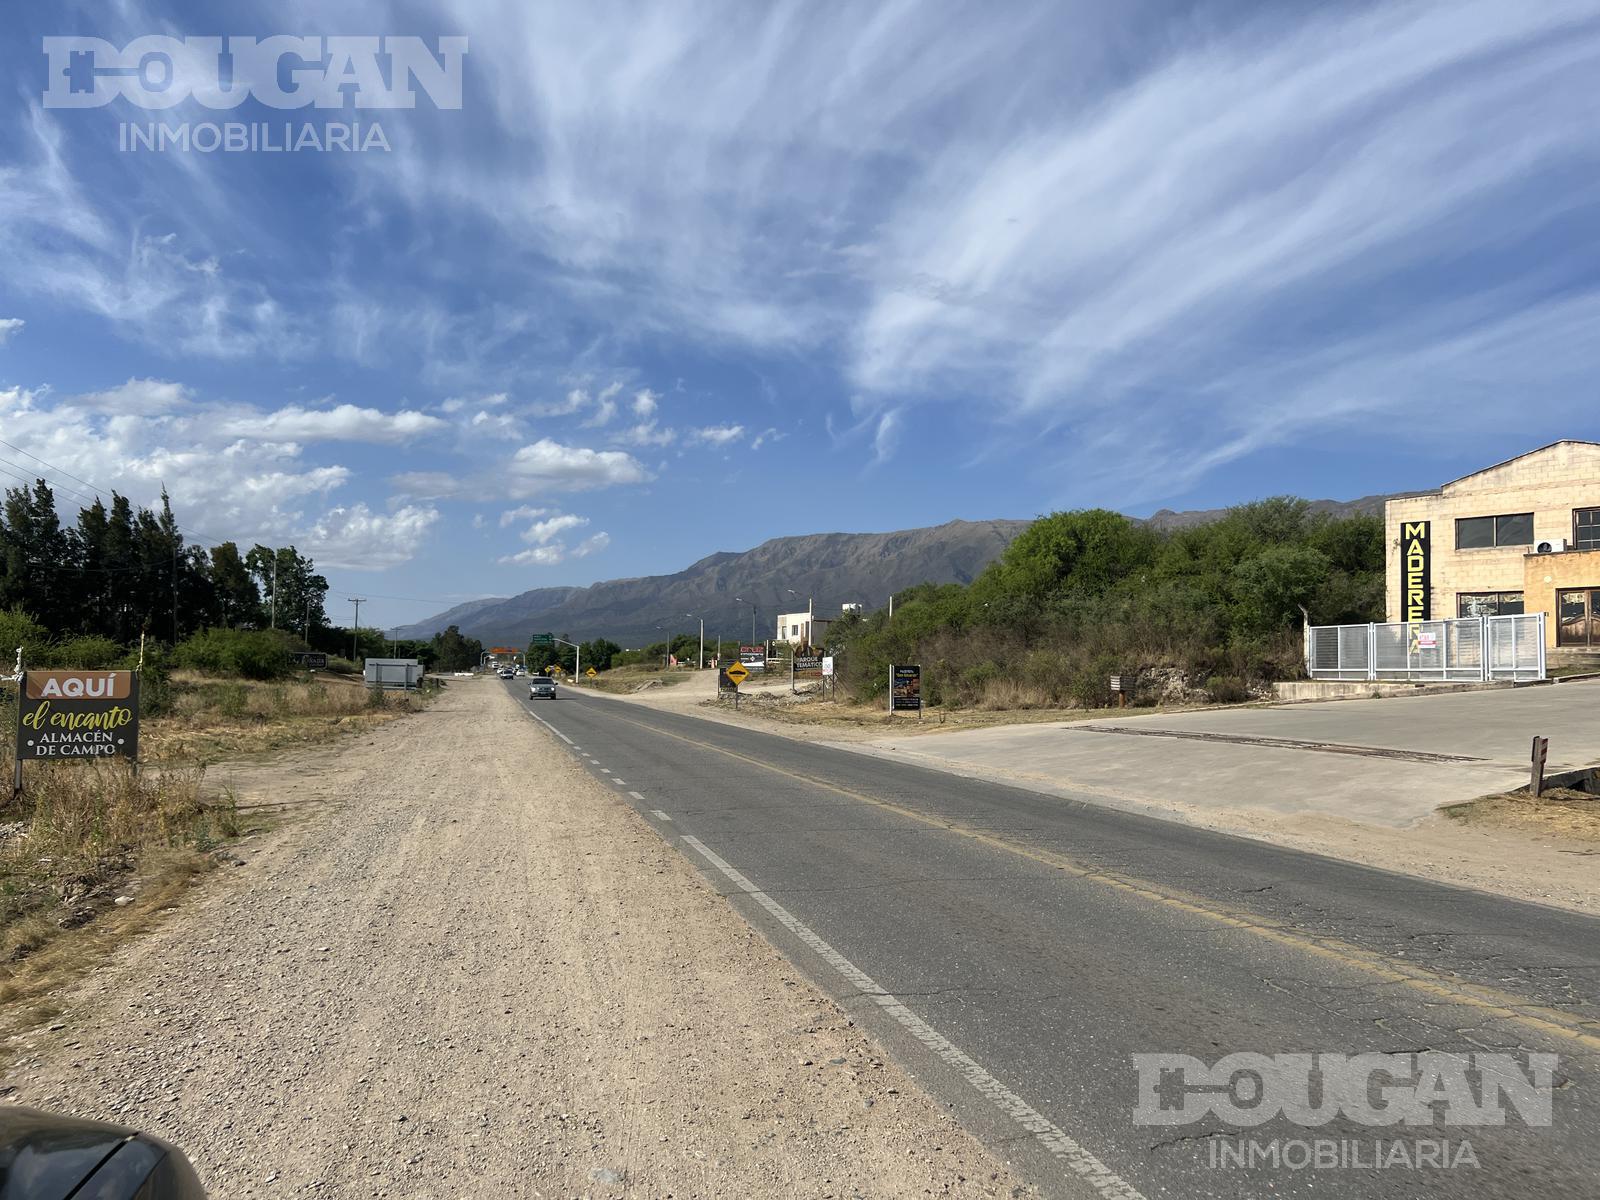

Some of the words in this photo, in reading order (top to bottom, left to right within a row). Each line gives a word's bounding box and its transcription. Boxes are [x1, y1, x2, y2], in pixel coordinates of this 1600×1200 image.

[1405, 521, 1425, 655] MADERERA
[41, 673, 117, 697] AQUÍ
[23, 701, 50, 730] el
[51, 706, 132, 731] encanto
[40, 730, 113, 743] ALMACÉN
[36, 745, 56, 756] DE
[60, 744, 116, 756] CAMPO
